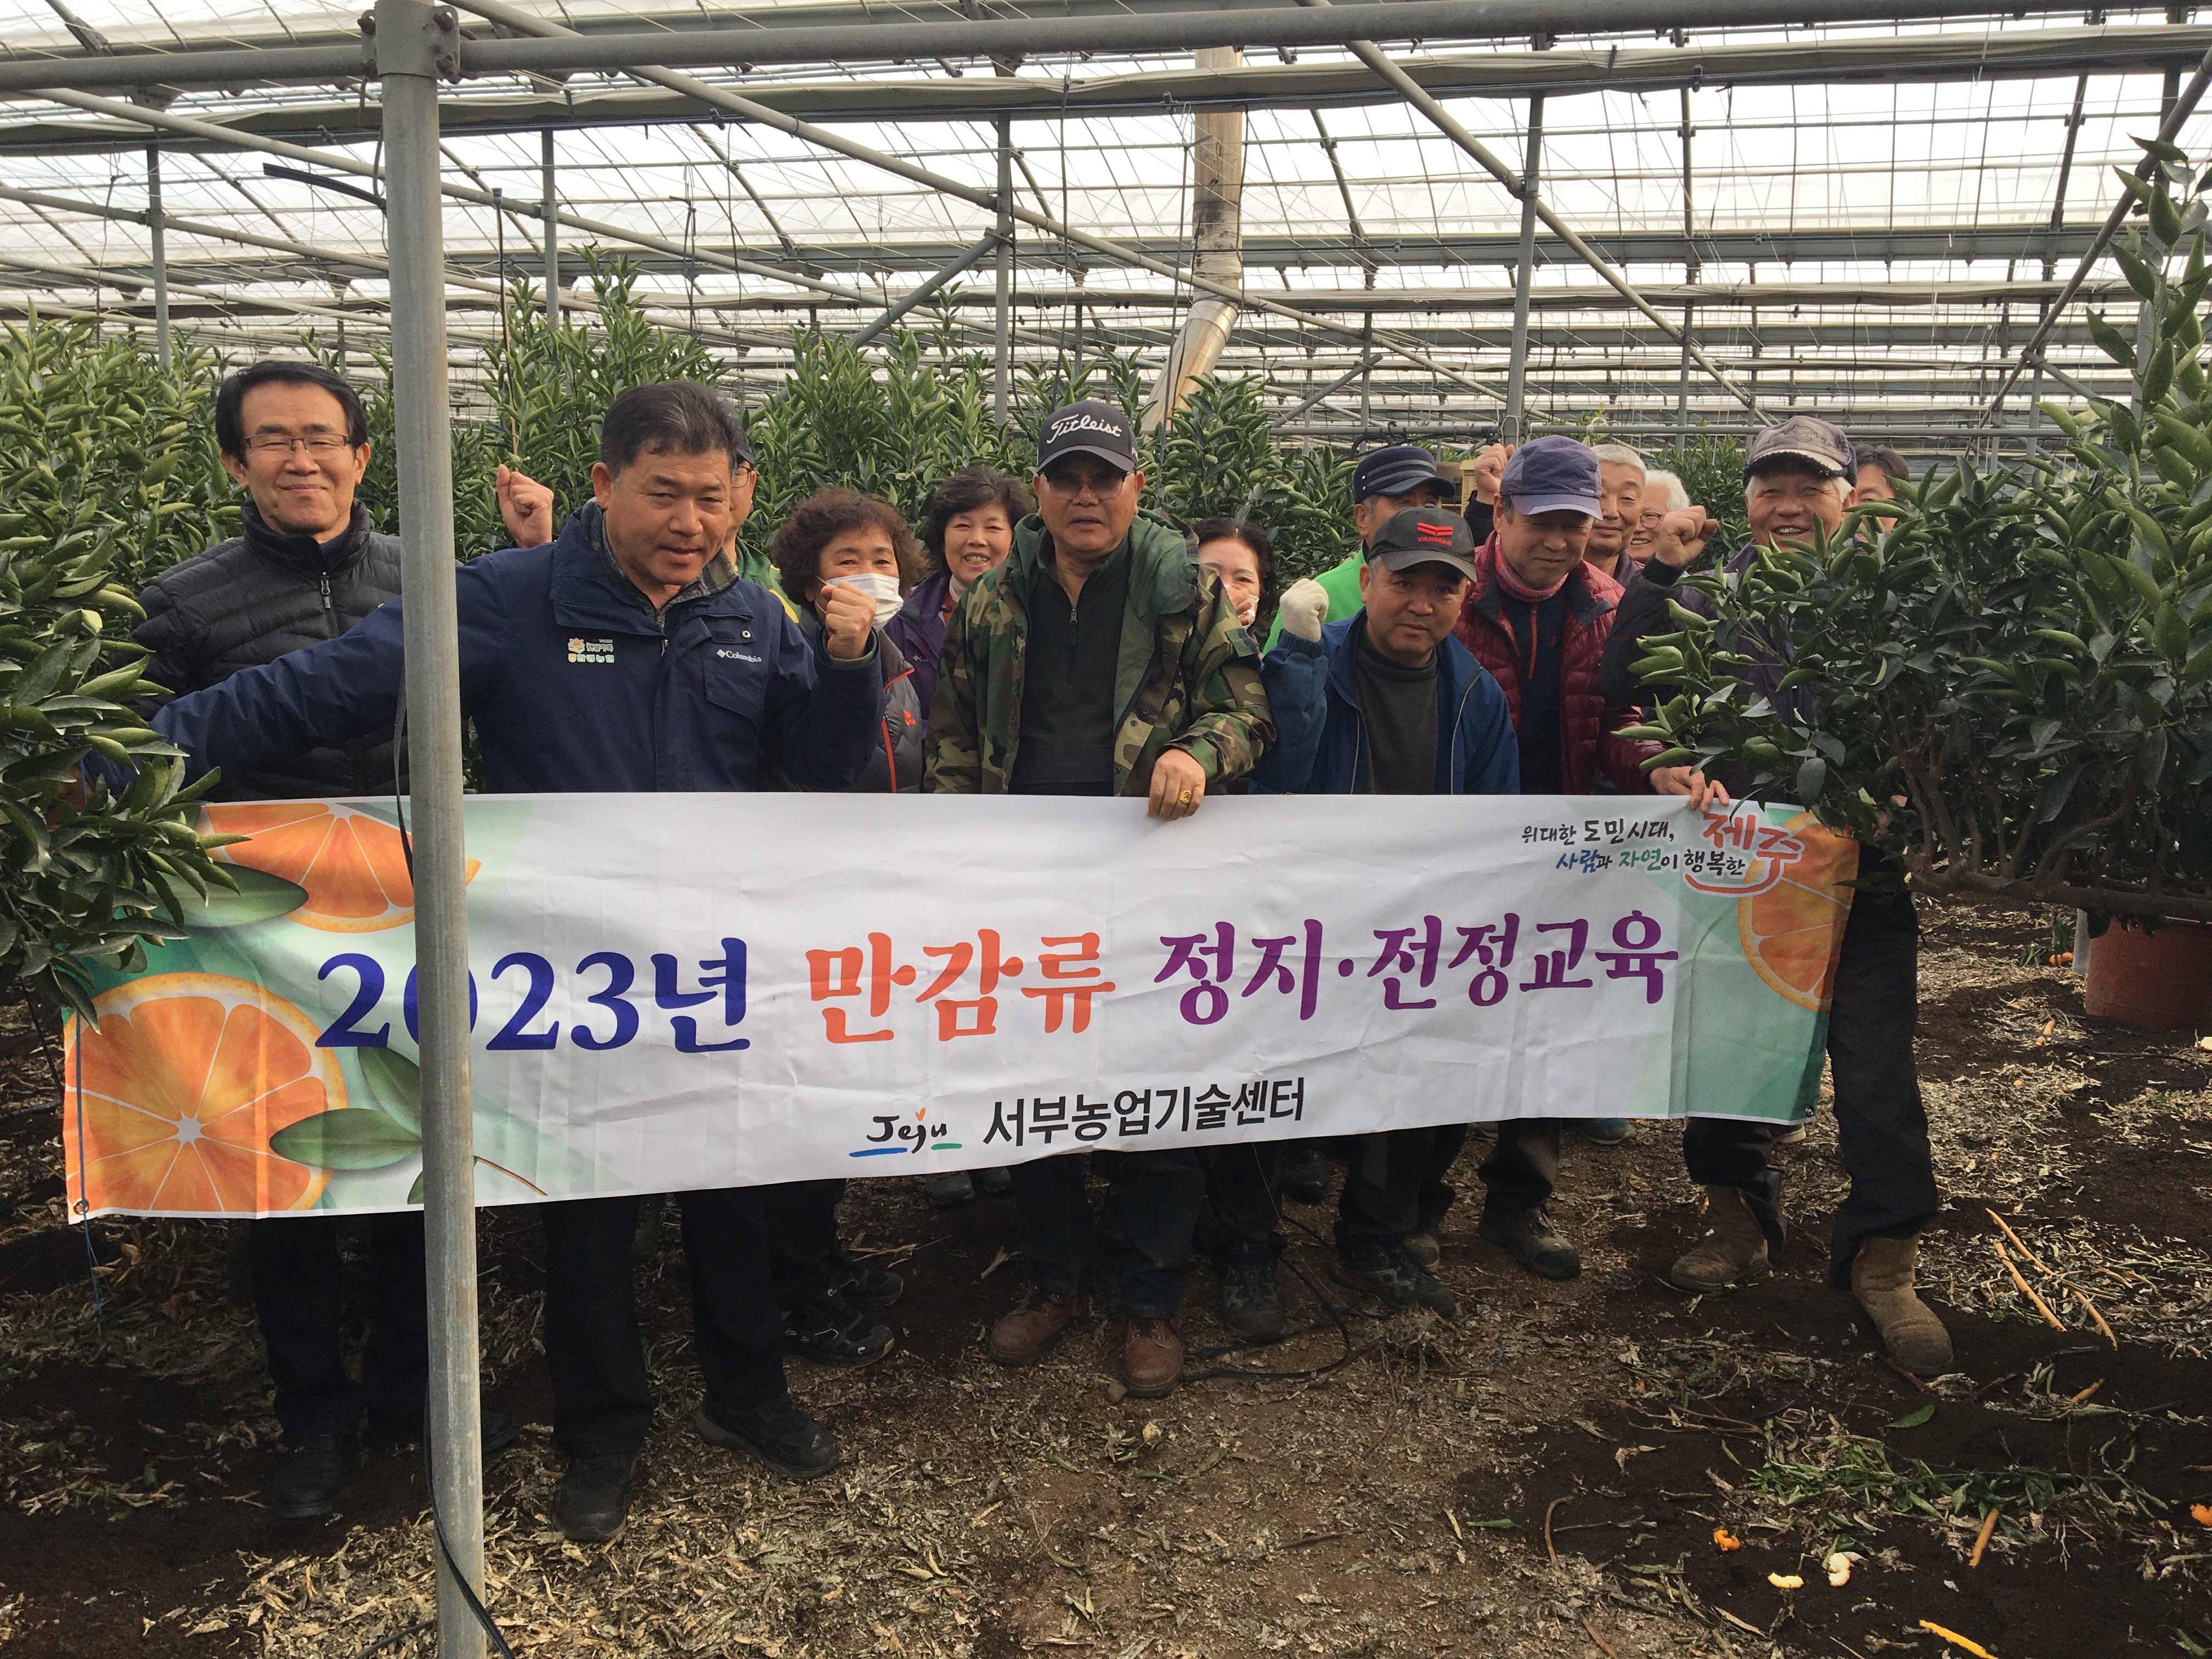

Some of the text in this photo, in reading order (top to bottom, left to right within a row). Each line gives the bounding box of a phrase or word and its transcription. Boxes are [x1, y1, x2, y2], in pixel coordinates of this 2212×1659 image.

[1046, 414, 1122, 444] Titleist
[1417, 537, 1452, 546] YANMAR
[725, 650, 762, 663] Columbia
[1522, 819, 1674, 845] 위대한 도민시대,
[1556, 813, 1802, 894] 사람과 자연이 행복한 제주
[805, 928, 1116, 1044] 만감류
[1154, 909, 1679, 1026] 정지·전정교육
[866, 1108, 948, 1154] Jeju
[983, 1077, 1304, 1147] 서부농업기술센터
